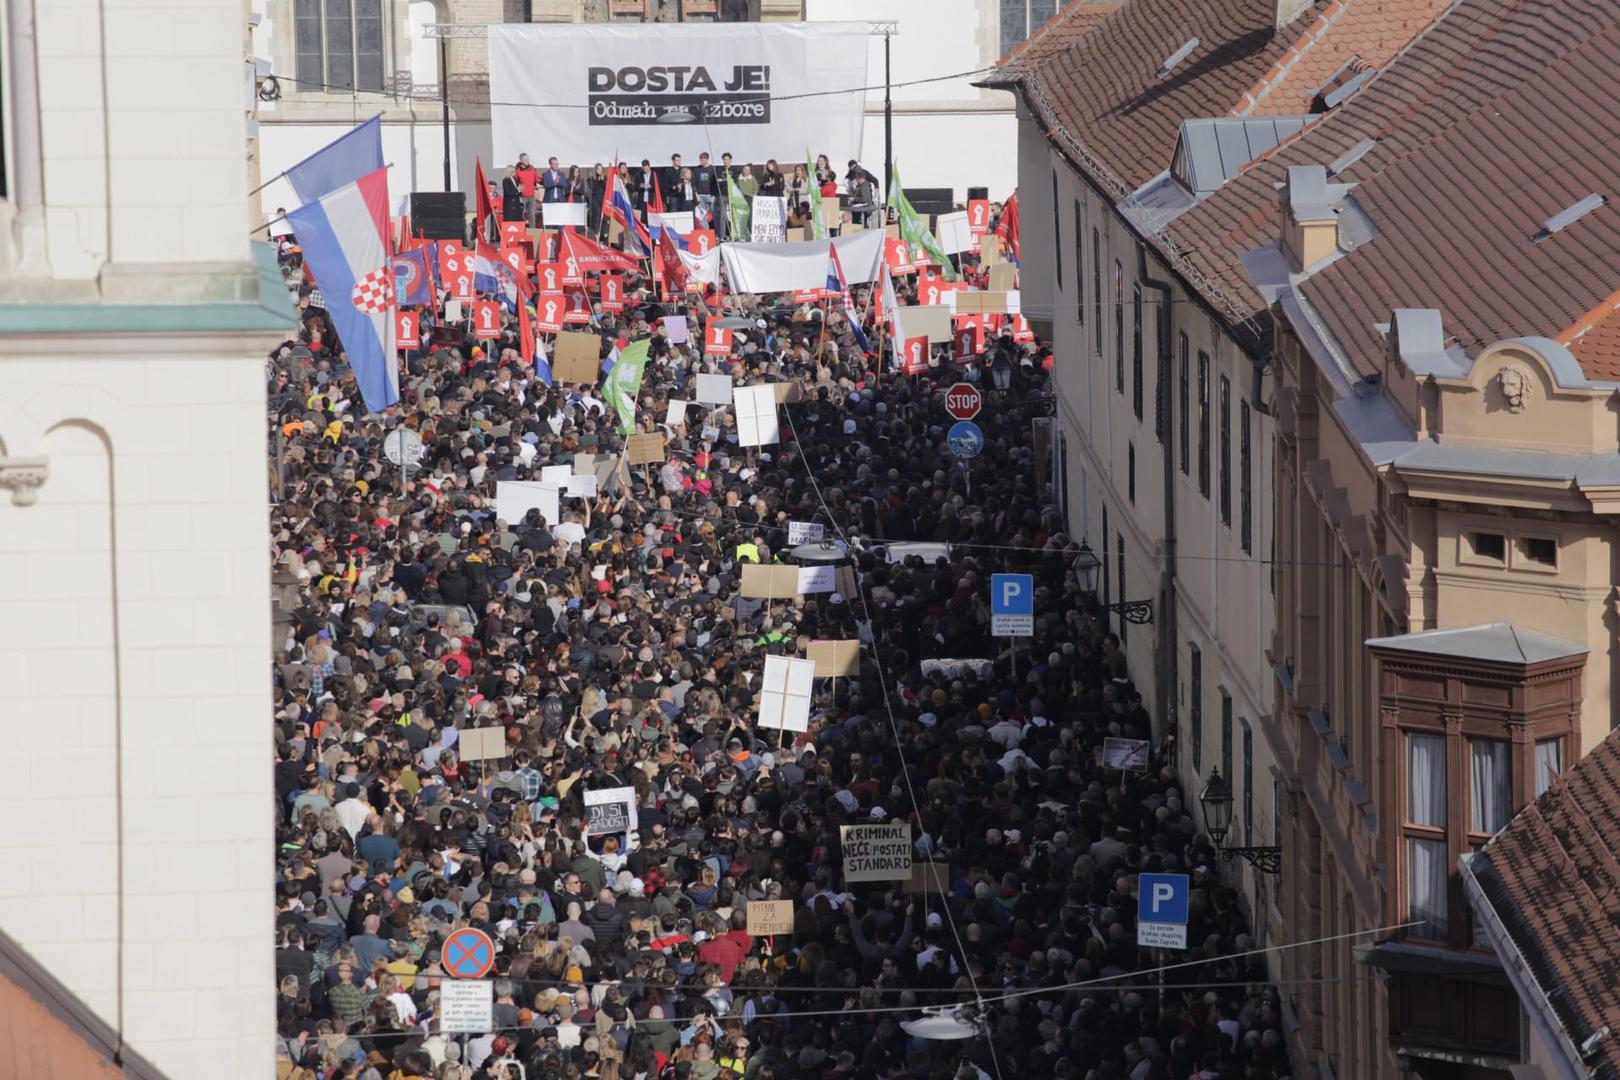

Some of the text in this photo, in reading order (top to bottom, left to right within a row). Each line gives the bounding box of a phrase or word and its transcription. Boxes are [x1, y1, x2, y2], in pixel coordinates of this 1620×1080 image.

[588, 65, 770, 92] DOSTA JE!
[594, 100, 657, 119] Odmah
[705, 100, 765, 118] izbore
[948, 394, 978, 409] STOP
[1003, 582, 1021, 607] P
[591, 803, 622, 819] DI SI
[846, 828, 906, 841] KRIMINAL
[872, 843, 910, 856] POSTATI
[849, 857, 911, 872] STANDARD
[1152, 883, 1174, 913] P
[762, 912, 776, 921] ZA
